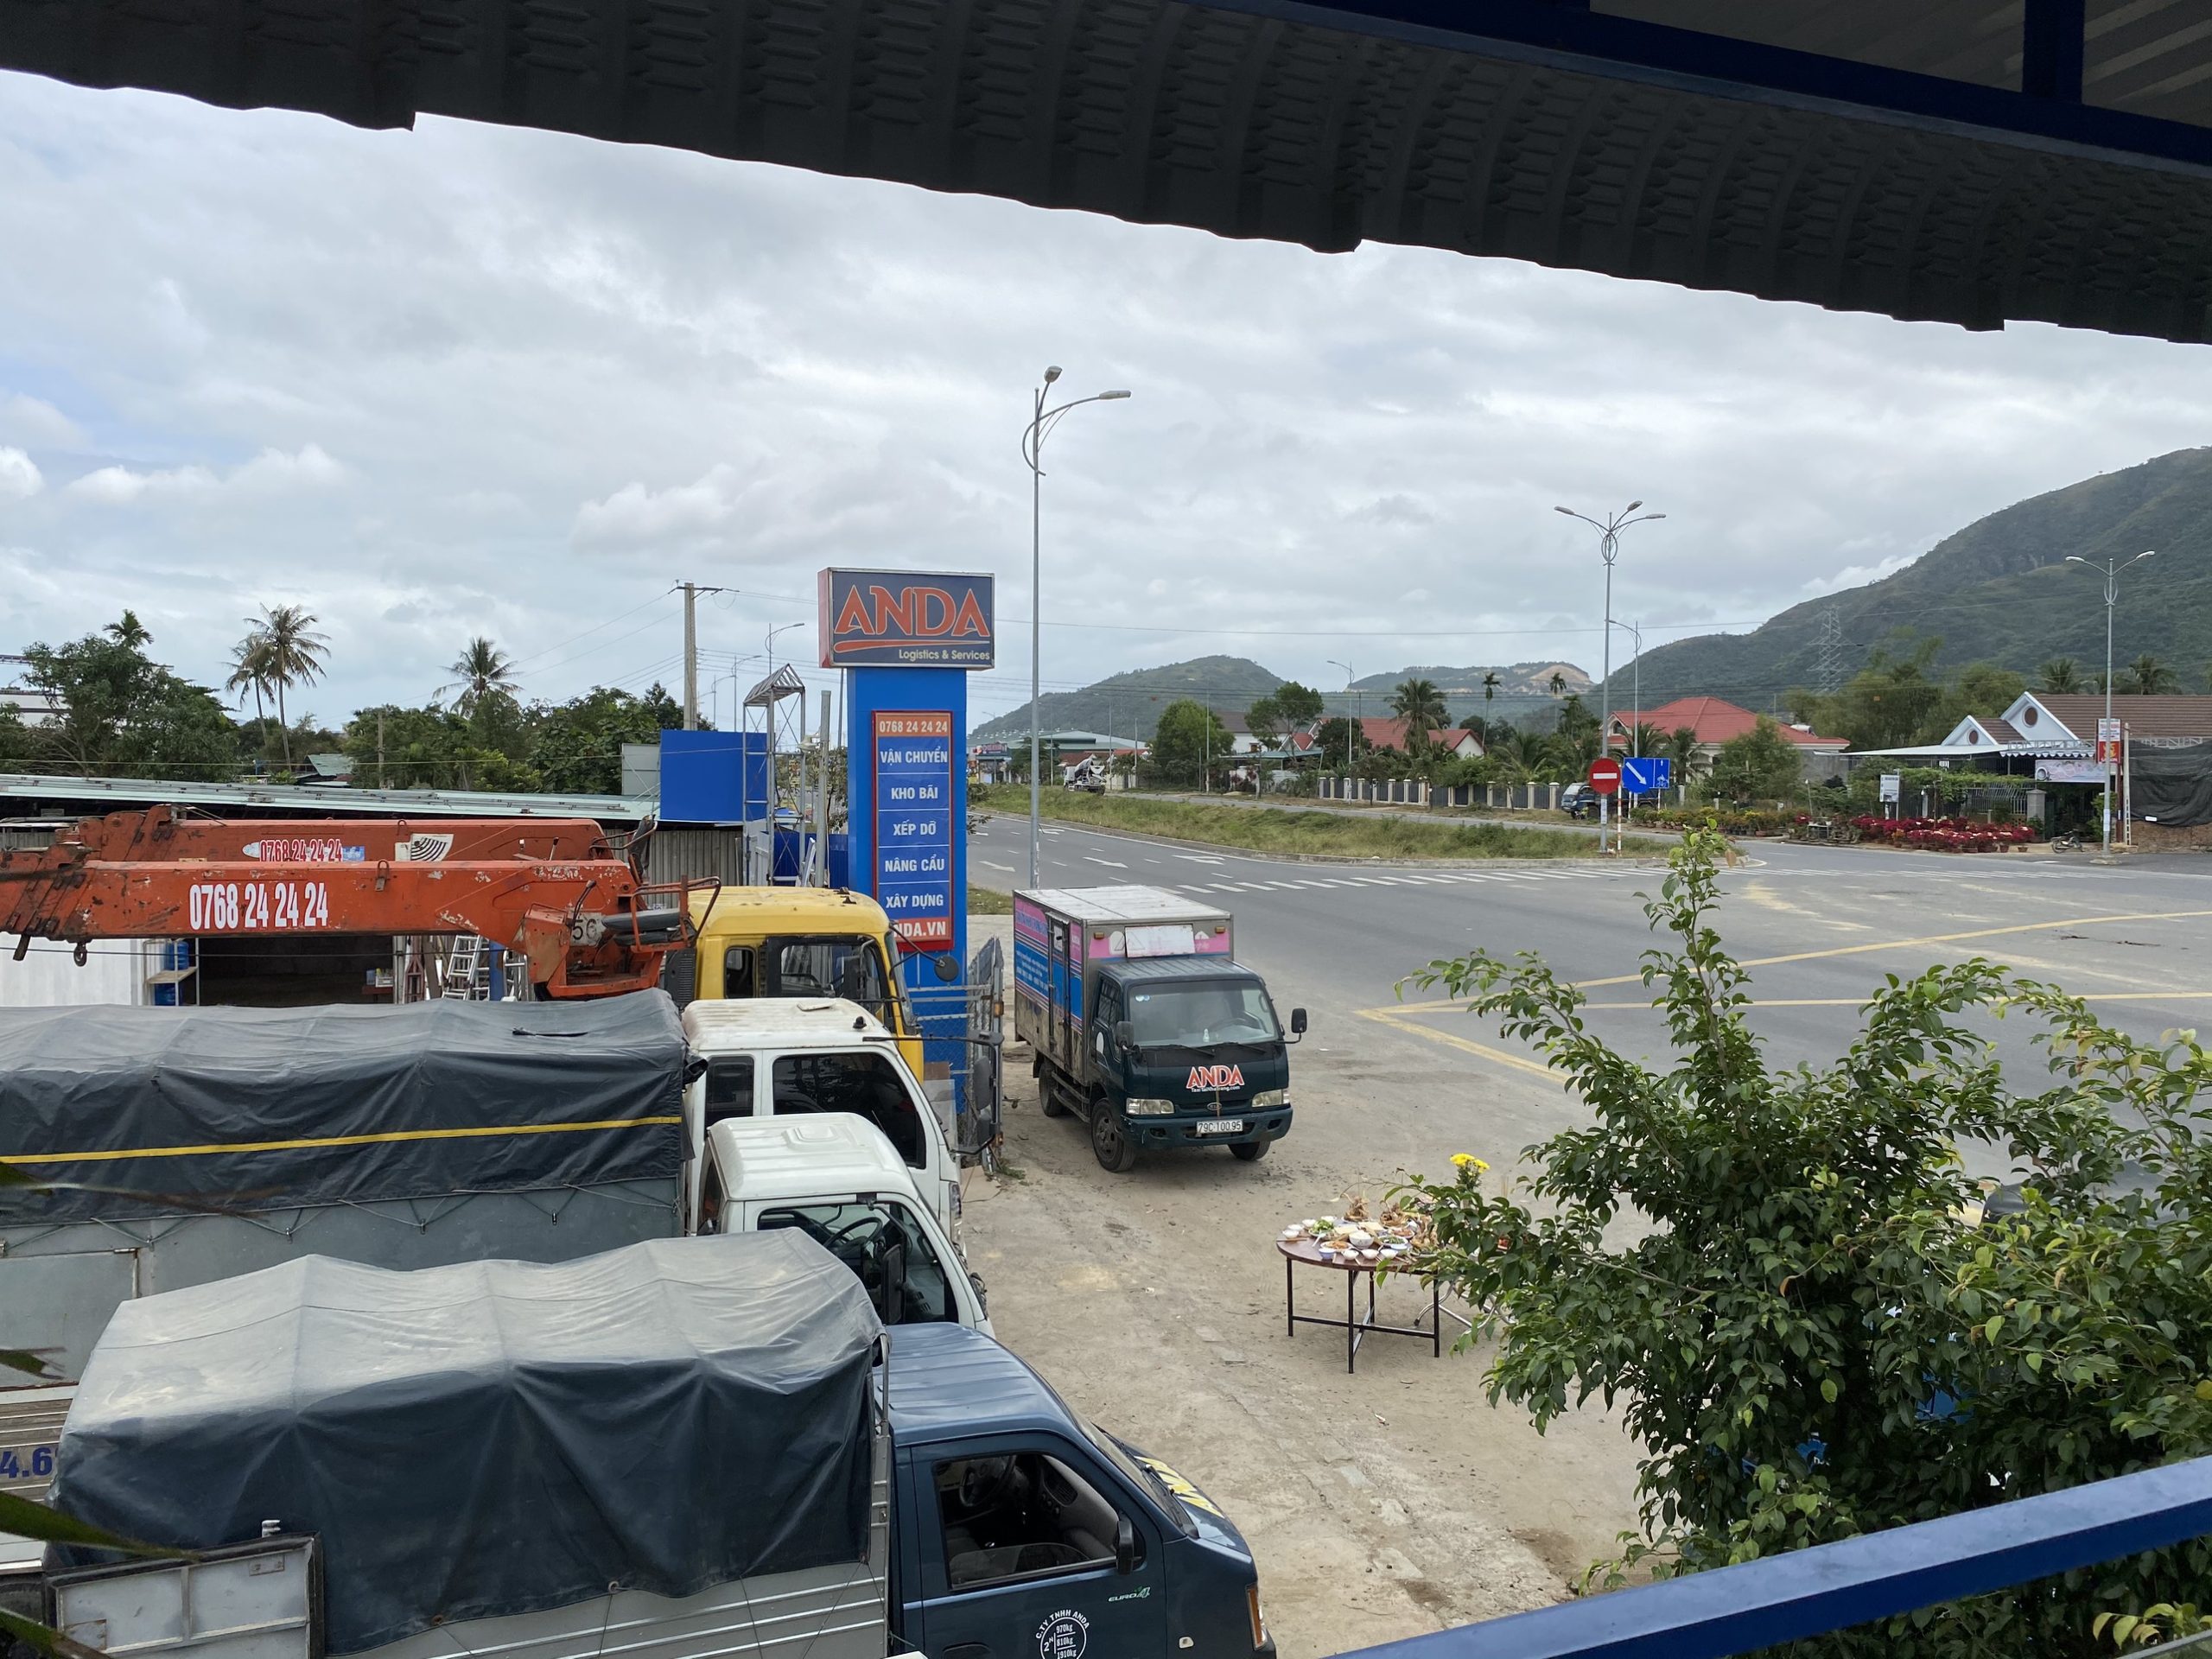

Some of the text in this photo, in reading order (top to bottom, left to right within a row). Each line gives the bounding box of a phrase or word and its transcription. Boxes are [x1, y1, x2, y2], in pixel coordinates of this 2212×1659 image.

[834, 584, 990, 637] ANDA
[899, 649, 990, 662] Logistics & Services
[880, 721, 948, 733] 0768 24 24 24
[880, 746, 948, 766] VẬN CHUYỂN
[891, 785, 938, 799] KHO BÃI
[893, 819, 916, 836] XẾP
[260, 839, 342, 861] 0768 24 24 24
[885, 854, 944, 872] NÂNG CẨU
[189, 881, 328, 931] 0768 24 24 24
[886, 893, 944, 910] XÂY DỰNG
[893, 921, 946, 938] NDA.VN
[1185, 1064, 1245, 1089] ANDA
[0, 1447, 59, 1478] 4.6
[1049, 1609, 1071, 1621] TNHH
[1071, 1611, 1090, 1630] ANDA
